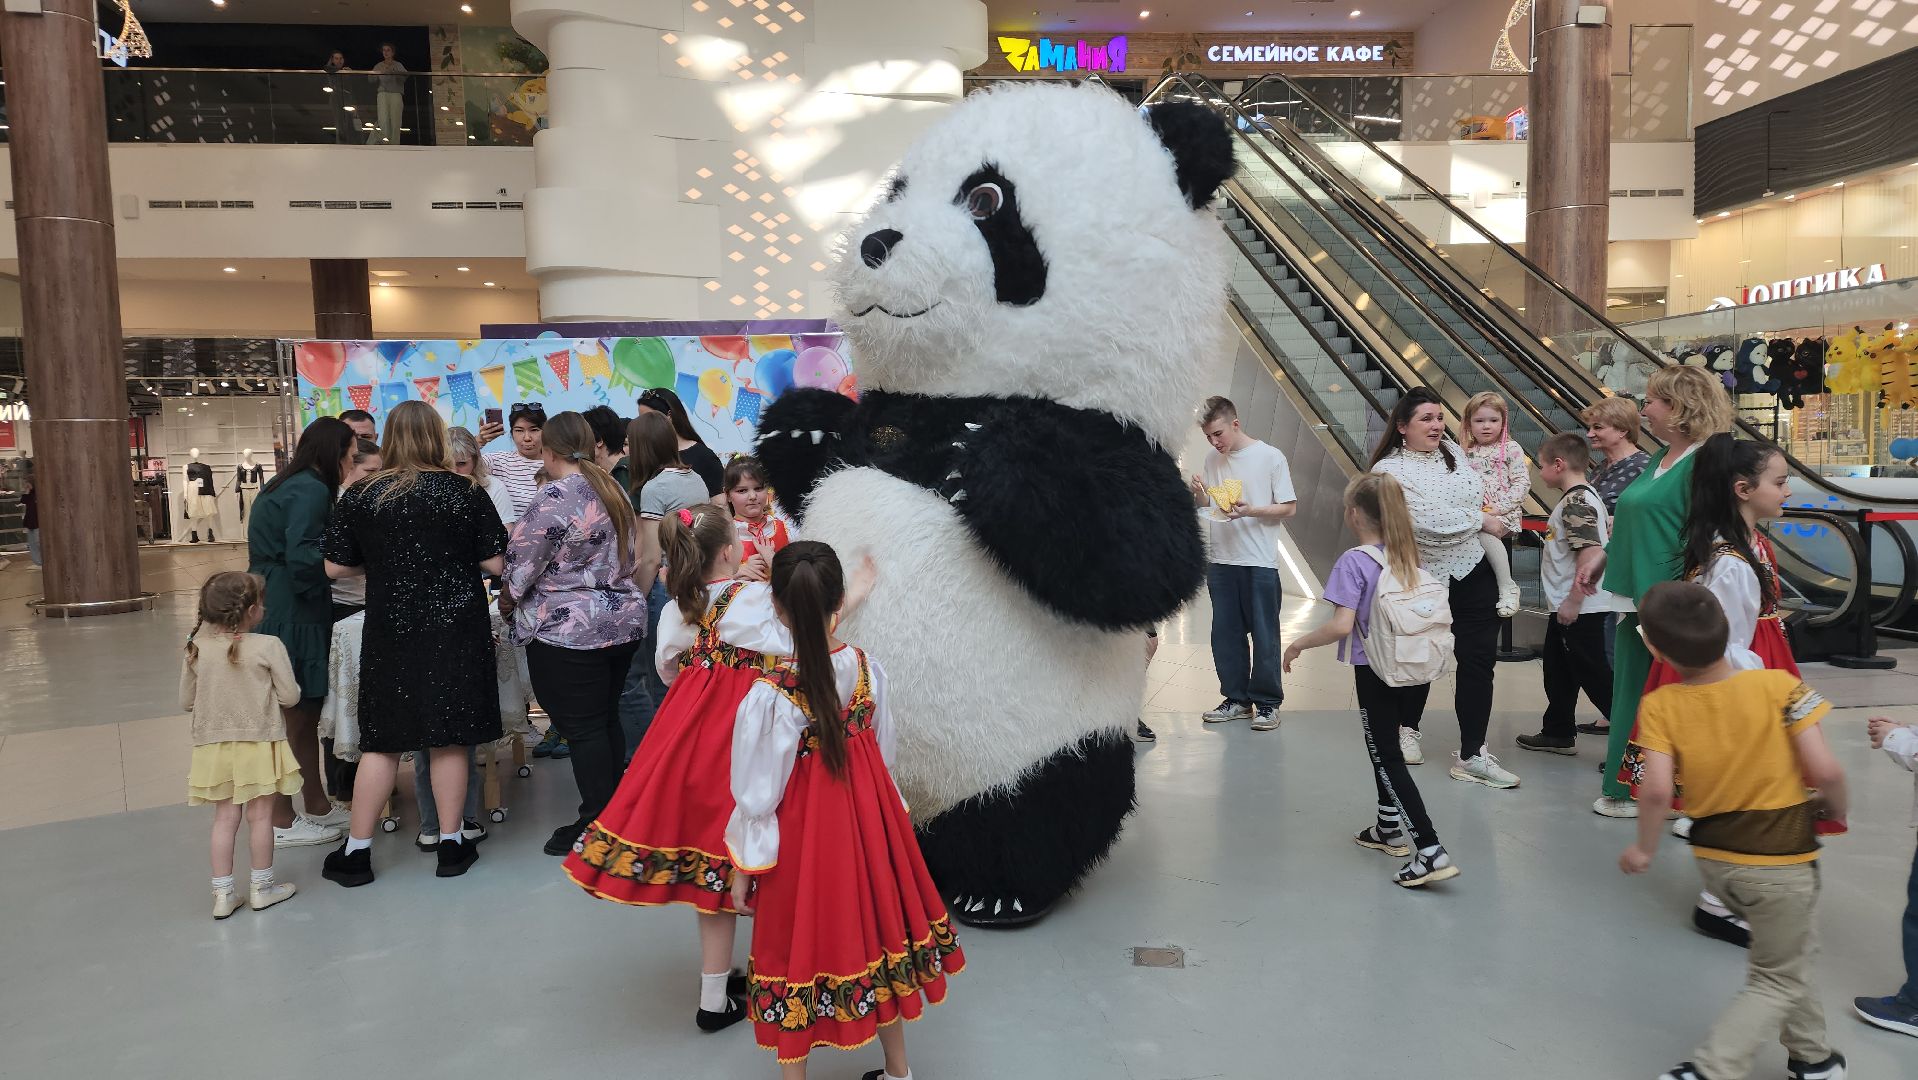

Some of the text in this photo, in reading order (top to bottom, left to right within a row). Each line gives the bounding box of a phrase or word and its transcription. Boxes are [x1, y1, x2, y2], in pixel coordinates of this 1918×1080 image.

[1208, 43, 1384, 62] СЕМЕЙНОЕ КАФЕ
[1748, 263, 1887, 304] ОПТИКА
